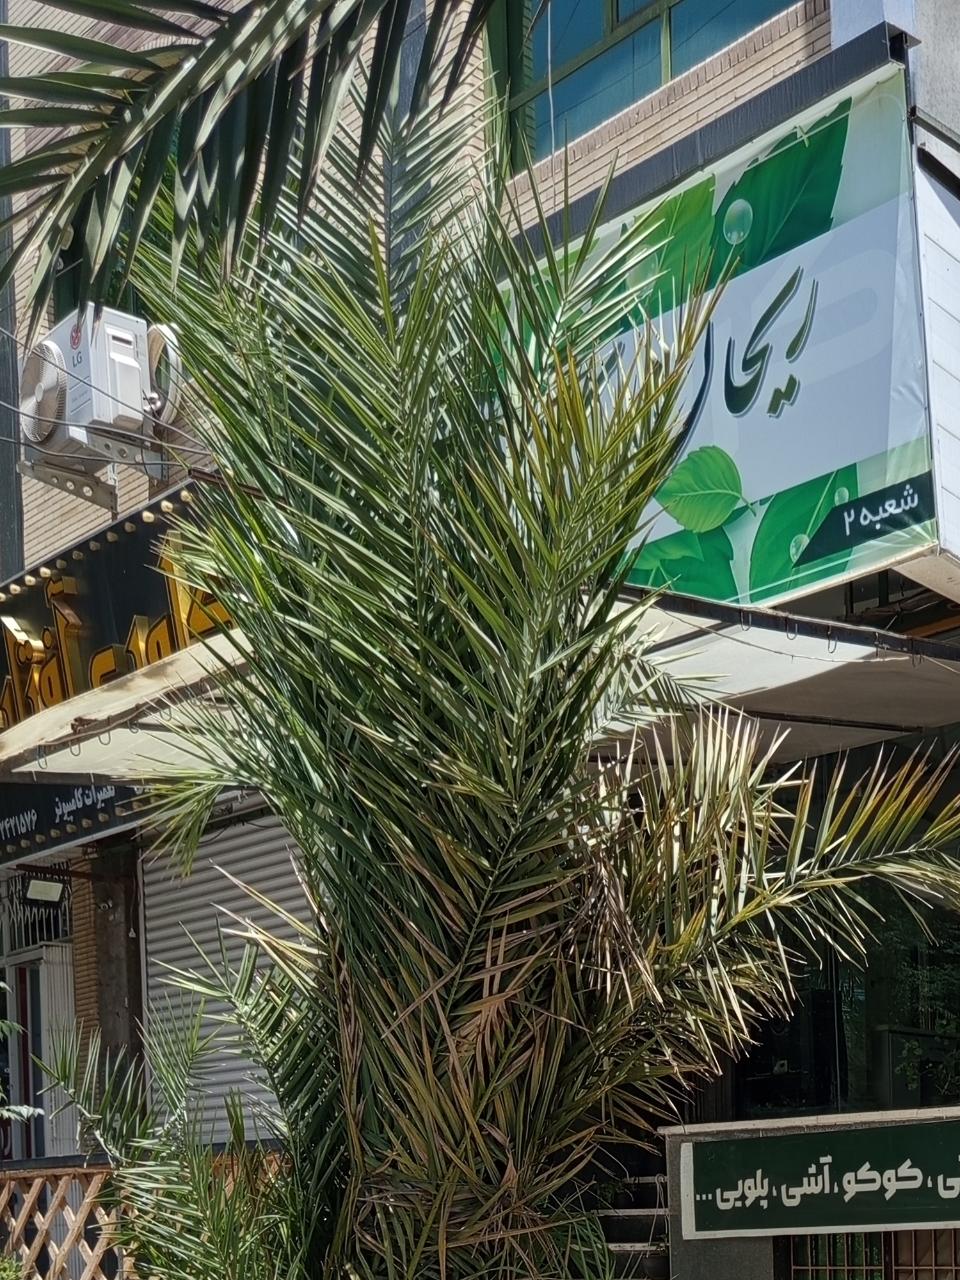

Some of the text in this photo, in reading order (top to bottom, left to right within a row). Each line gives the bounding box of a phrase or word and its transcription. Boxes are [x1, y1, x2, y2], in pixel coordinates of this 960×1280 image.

[72, 351, 83, 368] LG
[843, 484, 920, 537] شعبه ۲
